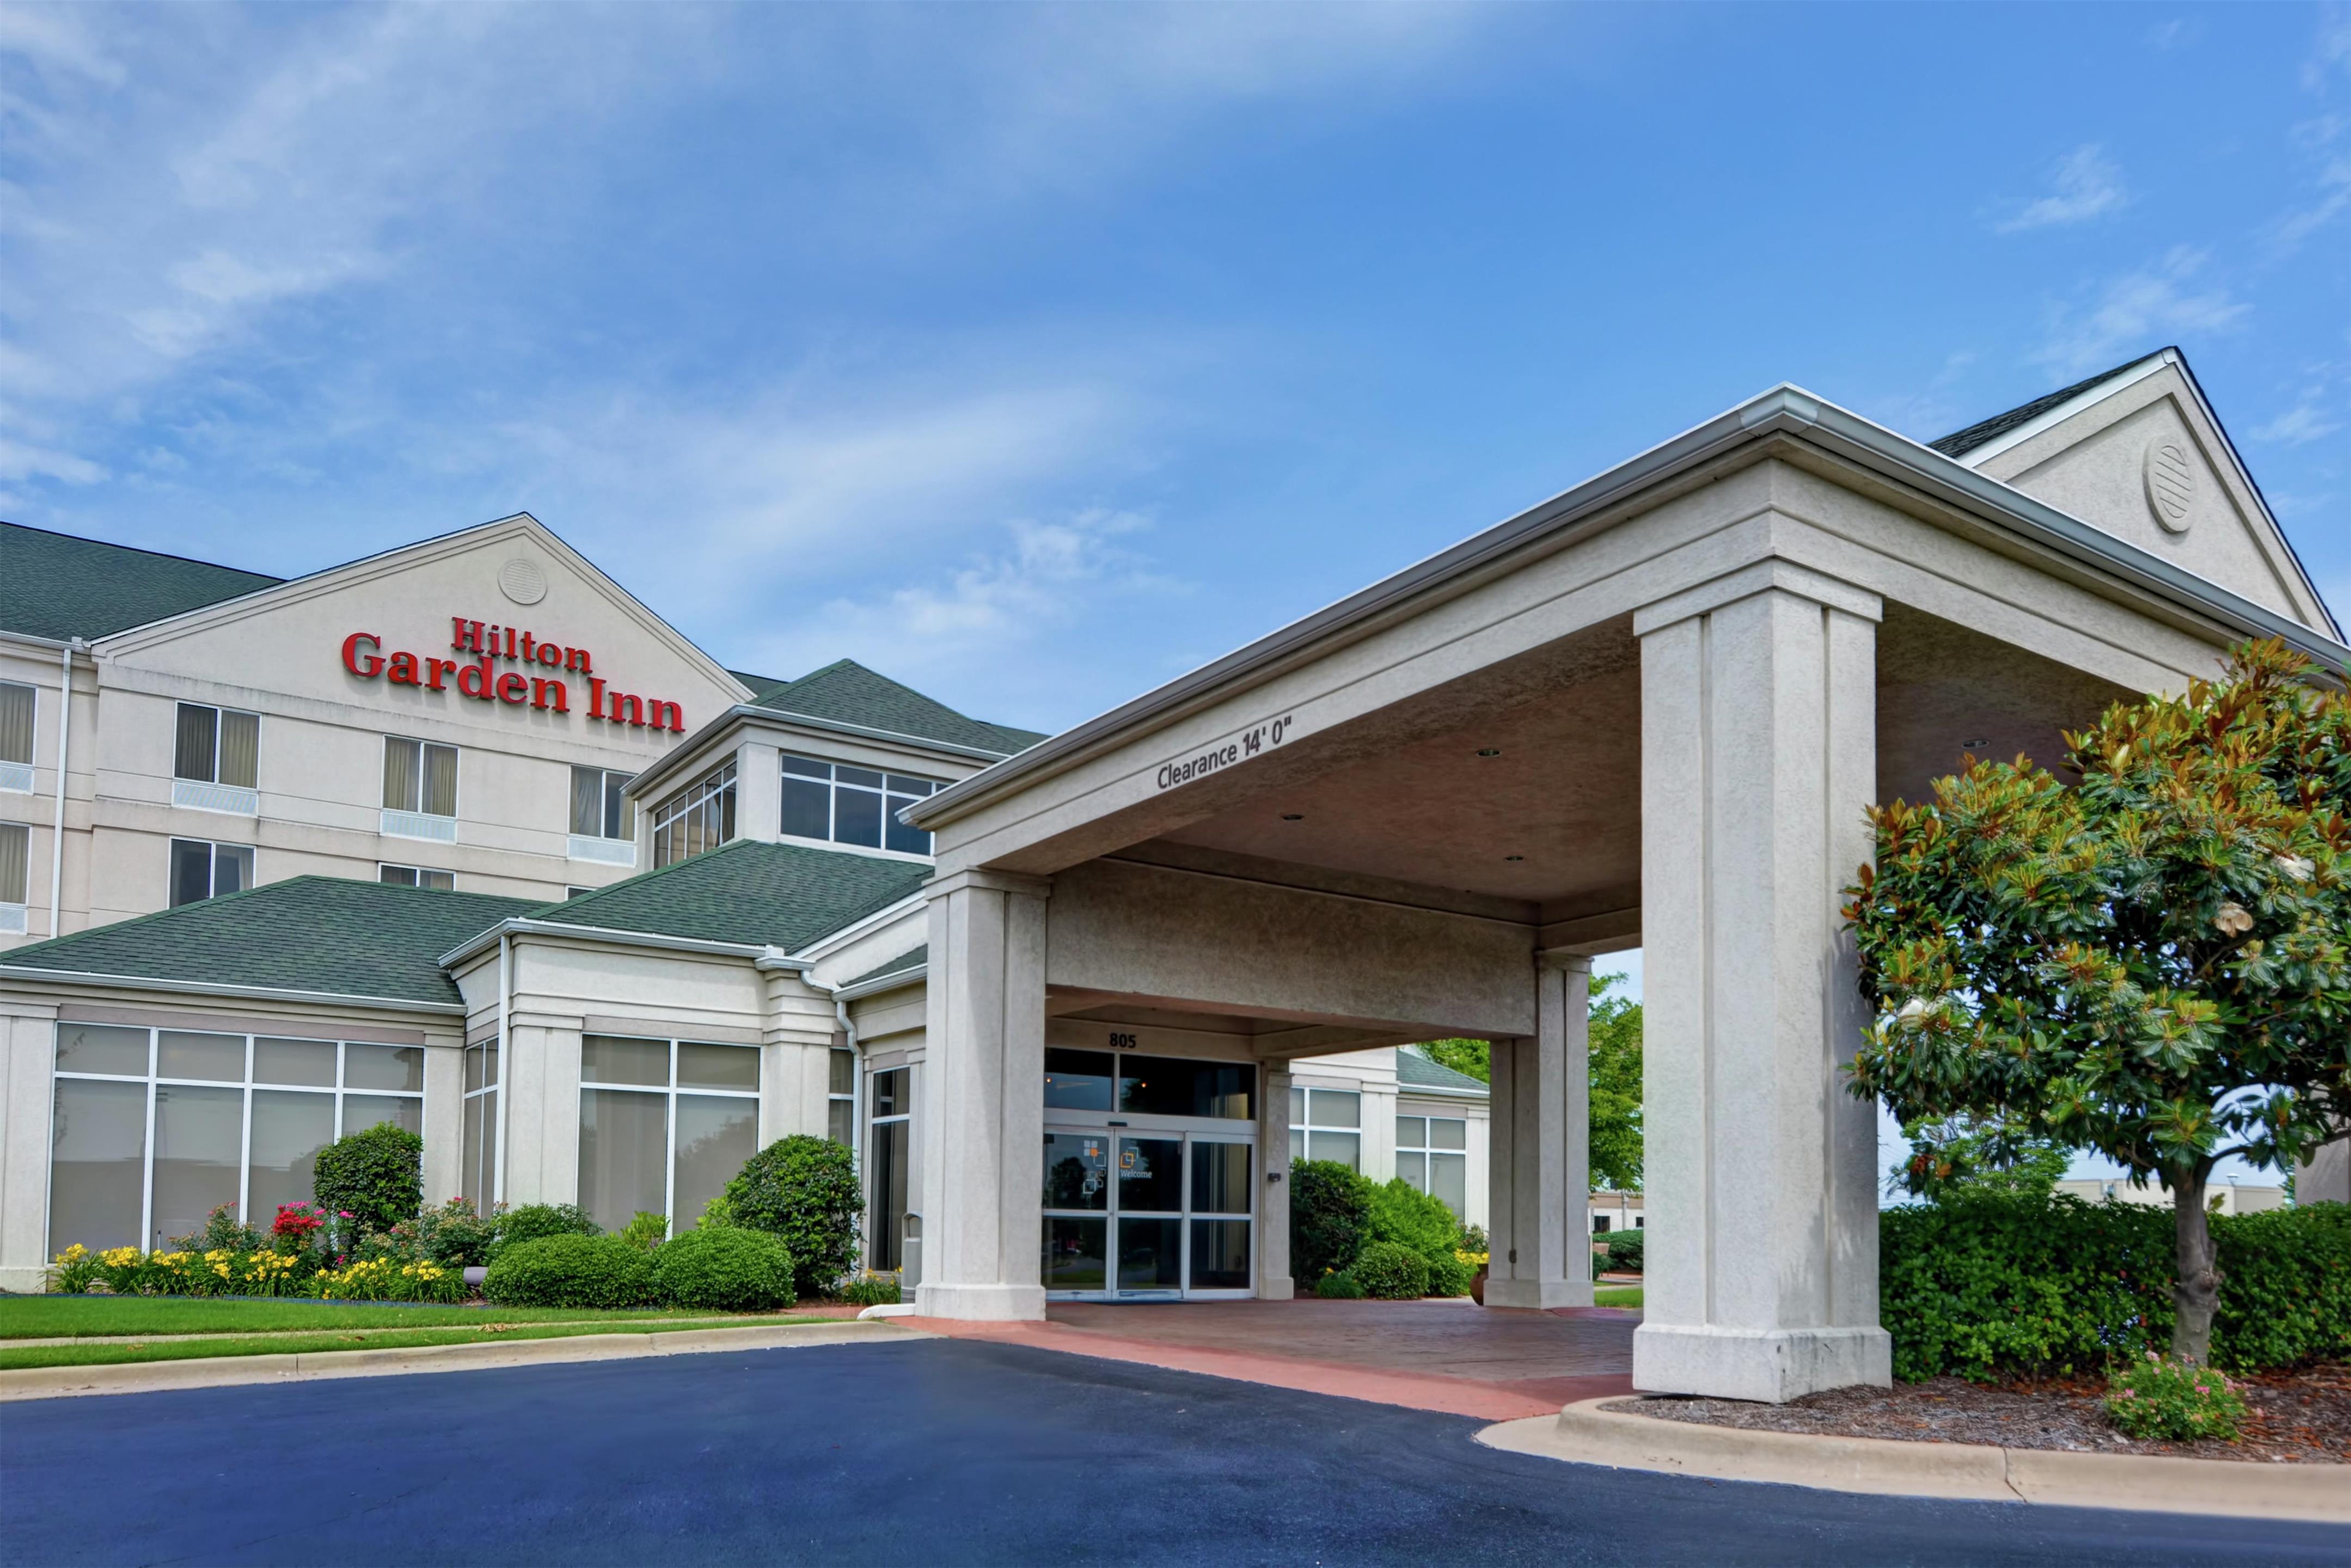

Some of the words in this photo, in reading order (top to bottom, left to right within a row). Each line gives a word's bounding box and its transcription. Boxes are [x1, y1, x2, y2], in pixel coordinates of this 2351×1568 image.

[451, 616, 593, 674] Hilton
[342, 632, 570, 713] Garden
[586, 677, 686, 733] Inn
[1158, 744, 1237, 789] Clearance
[1109, 1032, 1137, 1049] 805
[1120, 1169, 1153, 1179] Welcome
